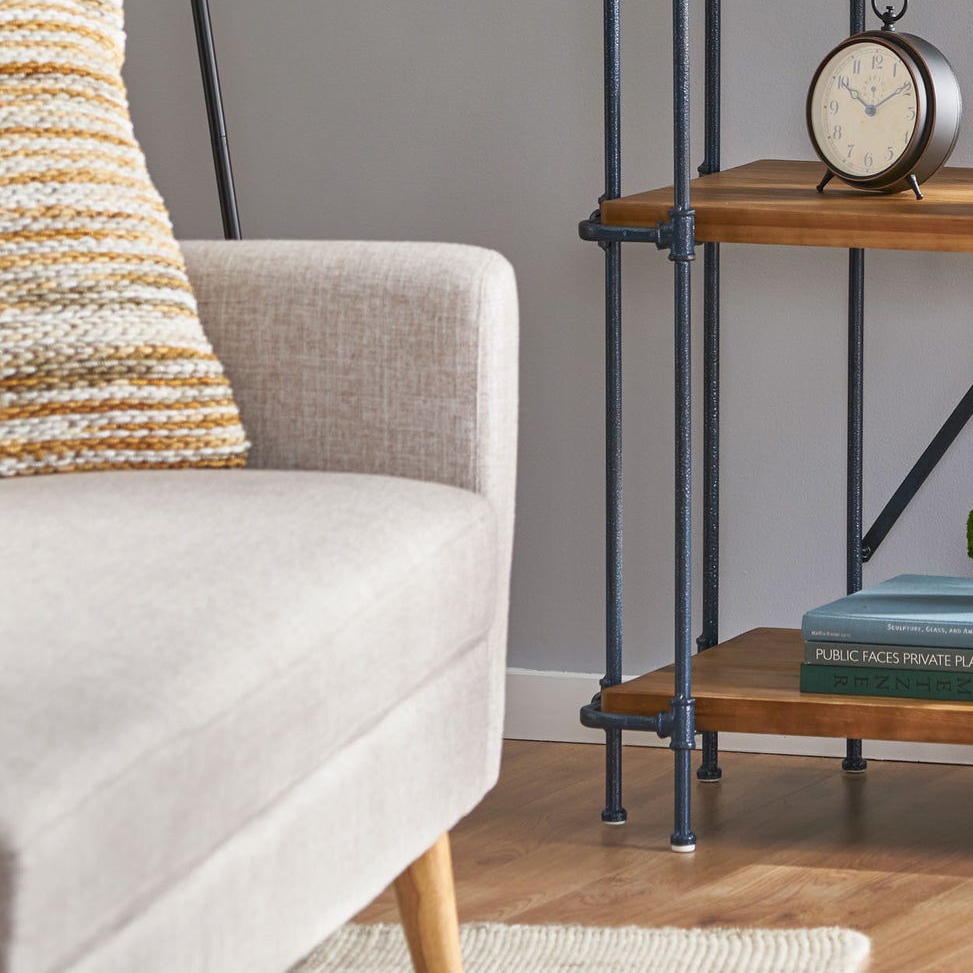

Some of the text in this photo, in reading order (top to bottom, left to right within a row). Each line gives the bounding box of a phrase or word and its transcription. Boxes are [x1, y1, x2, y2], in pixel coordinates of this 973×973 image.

[853, 60, 861, 74] 11
[871, 56, 883, 70] 12
[838, 76, 849, 89] 10
[903, 81, 912, 96] 2
[830, 100, 839, 115] 9
[833, 125, 842, 140] 8
[847, 144, 854, 158] 7
[885, 147, 894, 161] 5
[864, 153, 873, 167] 6
[888, 624, 923, 633] SCULPTURE,
[925, 626, 947, 634] GLASS,
[816, 648, 859, 662] PUBLIC
[862, 650, 899, 664] FACES
[903, 652, 951, 667] PRIVATE
